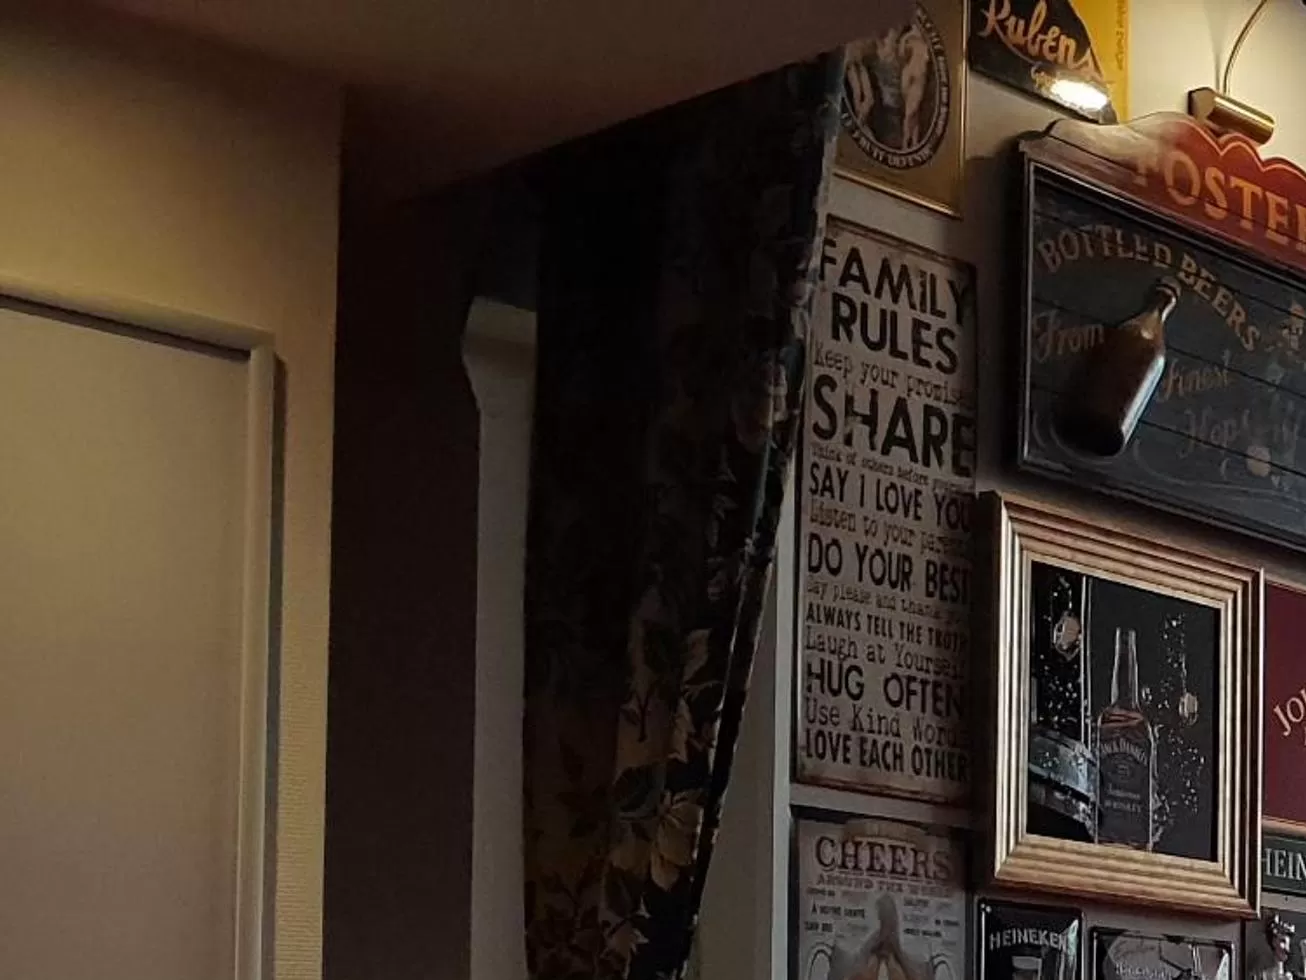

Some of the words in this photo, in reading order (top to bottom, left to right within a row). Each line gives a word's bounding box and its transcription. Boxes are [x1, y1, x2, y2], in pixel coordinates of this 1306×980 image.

[818, 238, 972, 326] FAMILY
[1036, 224, 1172, 273] BOTTLED
[1177, 252, 1261, 352] BEERS
[832, 291, 959, 375] RULES
[812, 374, 977, 478] SHARE
[810, 462, 849, 502] SAY
[860, 474, 865, 508] I
[876, 478, 923, 521] LOVE
[863, 515, 878, 538] to
[883, 521, 915, 548] your
[808, 532, 843, 577] DO
[855, 542, 913, 593] YOUR
[925, 559, 972, 605] BEST
[805, 601, 862, 632] ALWAYS
[866, 613, 895, 640] TELL
[898, 620, 922, 645] THE
[806, 625, 859, 662] Laugh
[865, 643, 886, 665] at
[805, 696, 841, 727] Use
[851, 703, 902, 738] Kind
[806, 656, 865, 702] HUG
[882, 671, 965, 721] OFTEN
[804, 727, 853, 765] LOVE
[859, 735, 905, 773] EACH
[910, 744, 970, 784] OTHER
[816, 836, 950, 880] CHEERS
[989, 927, 1067, 951] HEINEKEN
